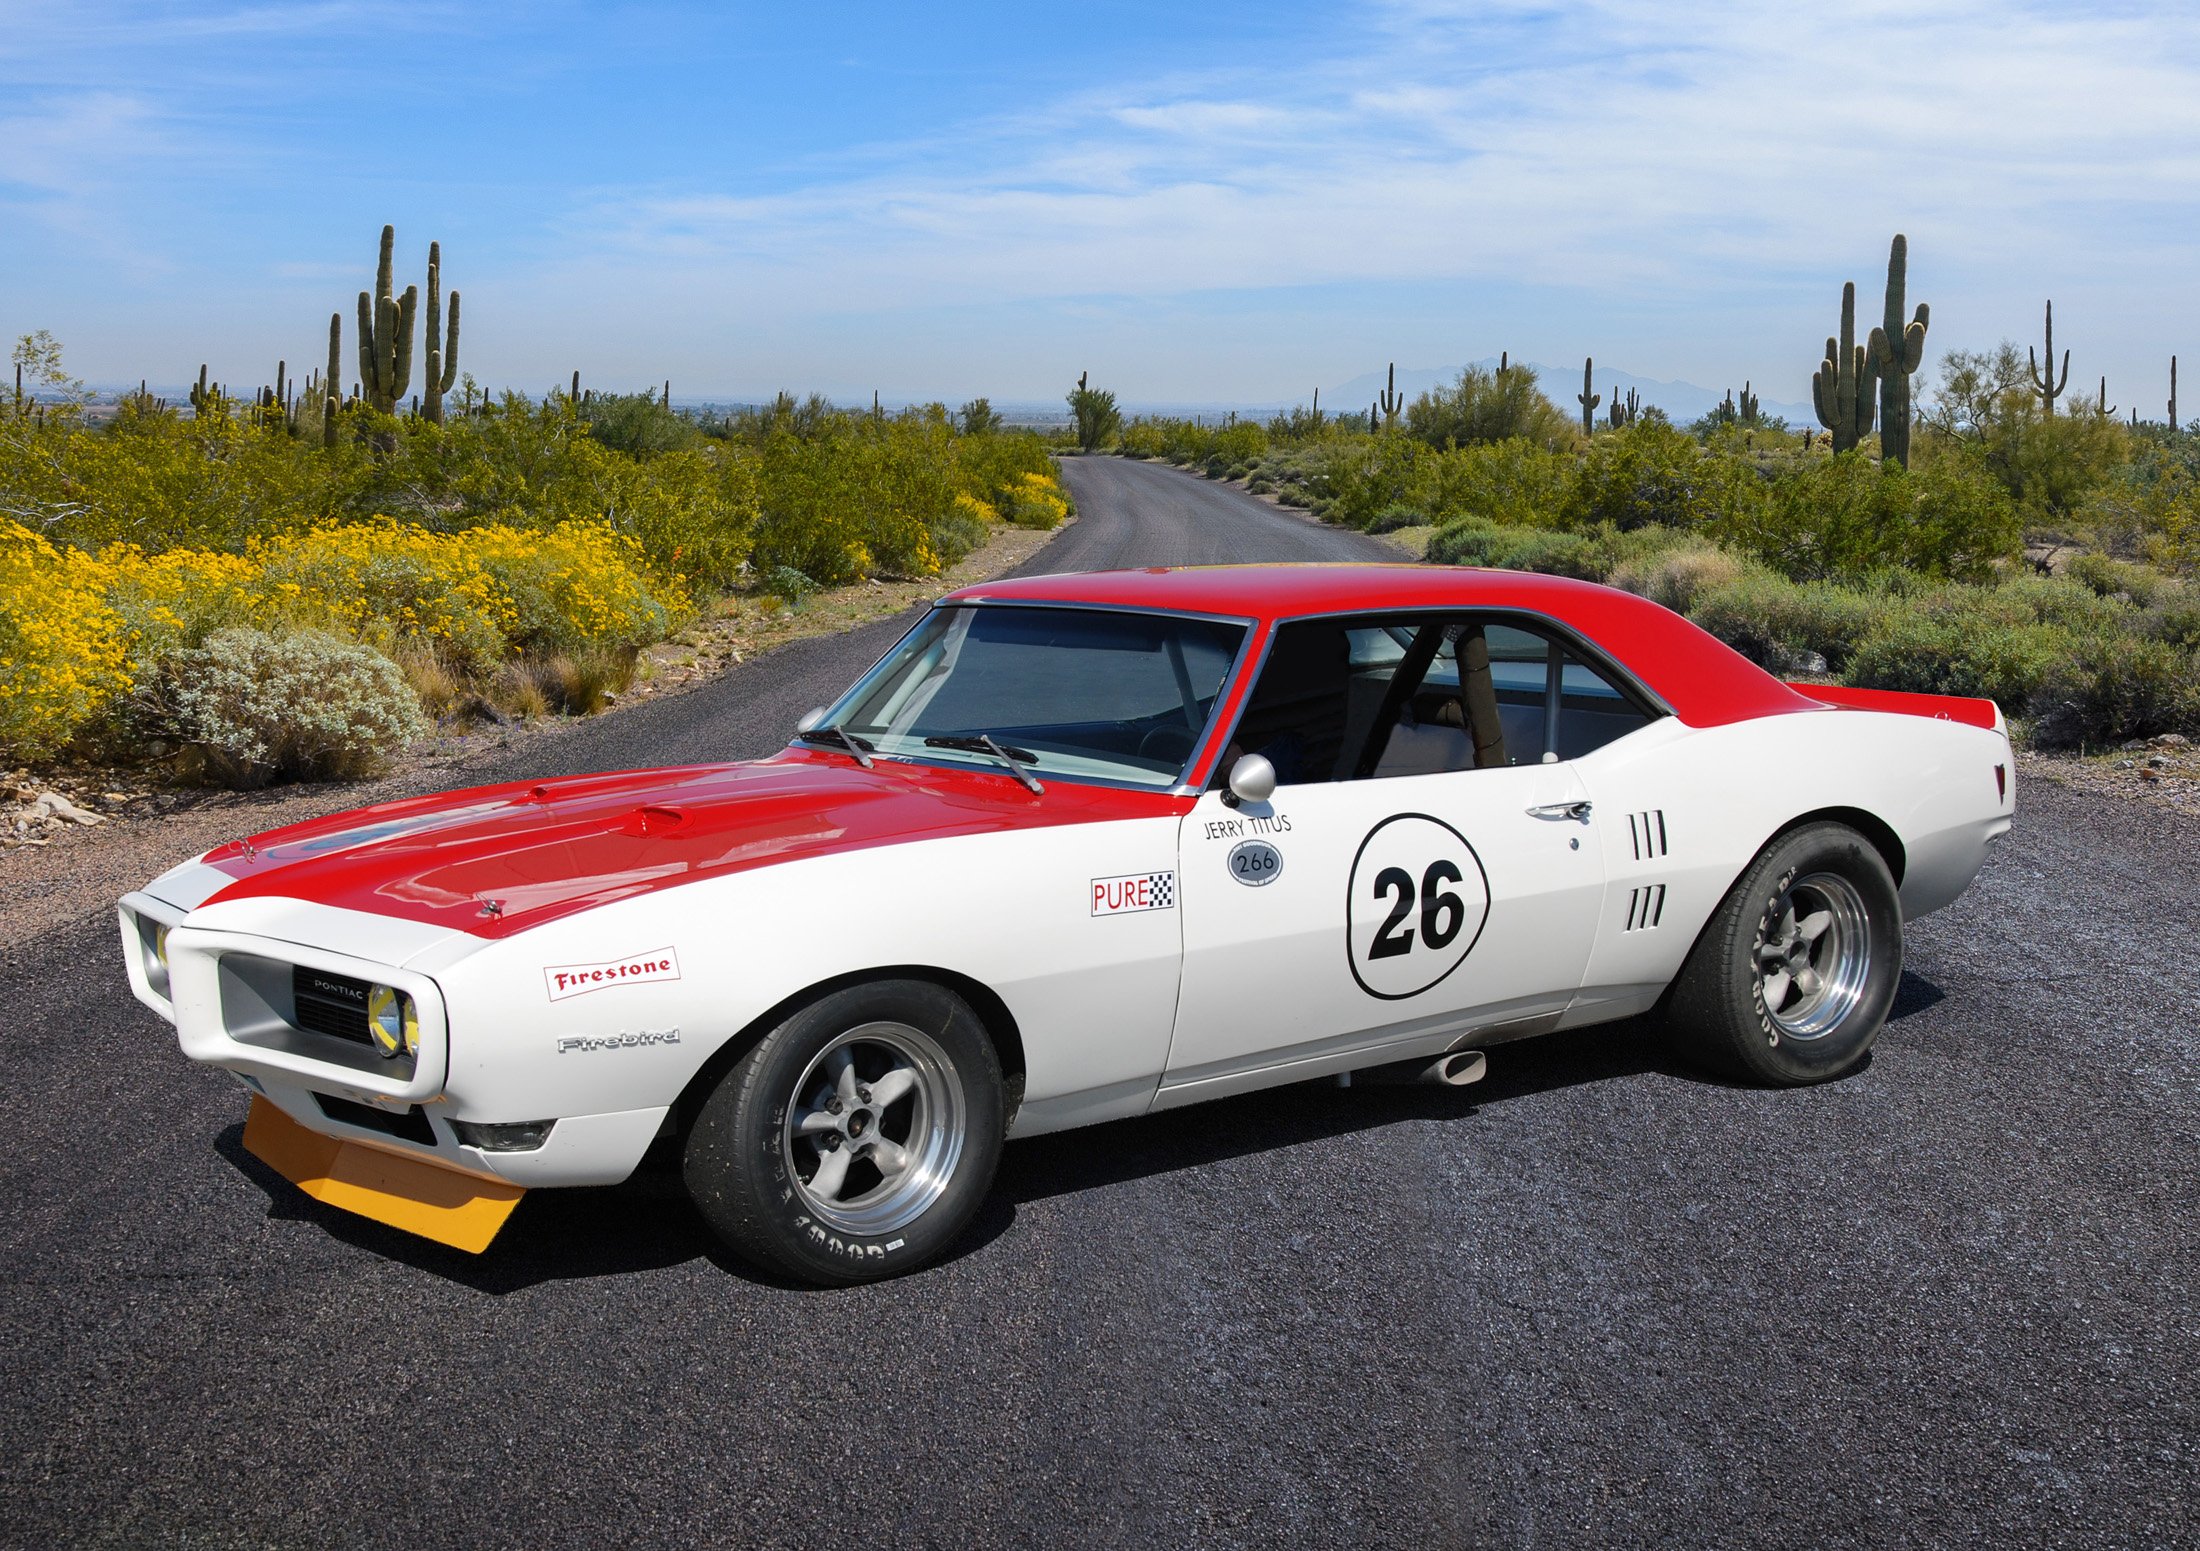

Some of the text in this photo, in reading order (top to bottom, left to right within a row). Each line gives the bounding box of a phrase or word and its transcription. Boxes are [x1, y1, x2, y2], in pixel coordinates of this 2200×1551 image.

[1204, 814, 1291, 840] JERRY TITUS
[1237, 851, 1274, 873] 266
[1094, 879, 1148, 911] PURE
[1367, 859, 1465, 961] 26
[314, 979, 363, 1000] PONTIAC
[554, 959, 671, 991] Firestone
[557, 1024, 681, 1054] Firebird
